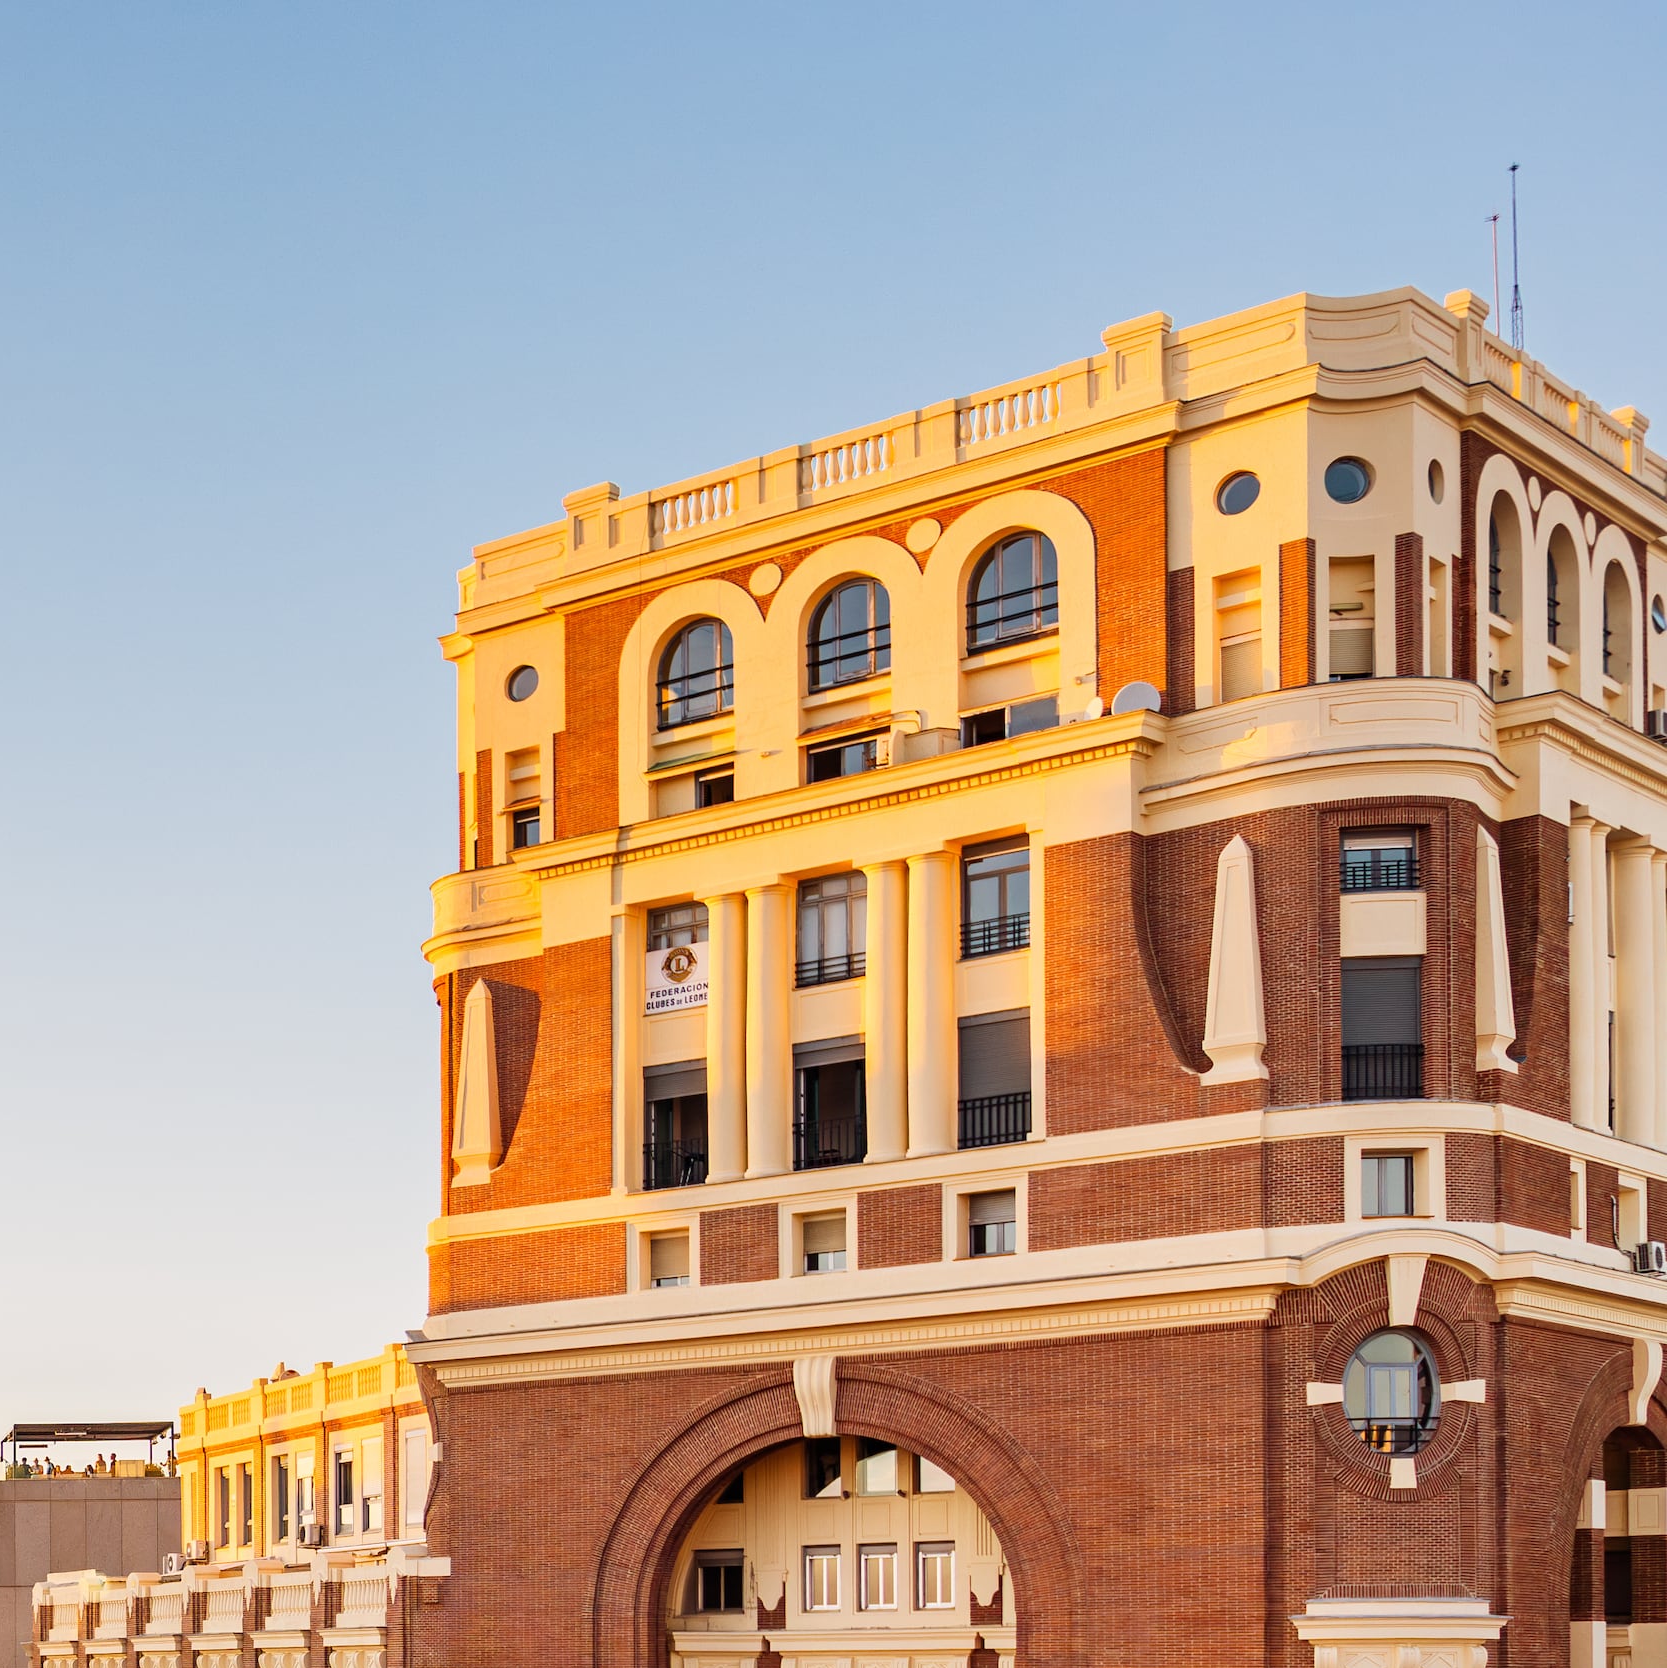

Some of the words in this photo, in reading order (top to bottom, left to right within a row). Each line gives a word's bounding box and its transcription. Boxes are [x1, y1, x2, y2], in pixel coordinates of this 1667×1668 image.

[650, 982, 709, 999] FEDERACION
[646, 998, 675, 1010] CLUBES
[684, 992, 708, 1004] LEONE
